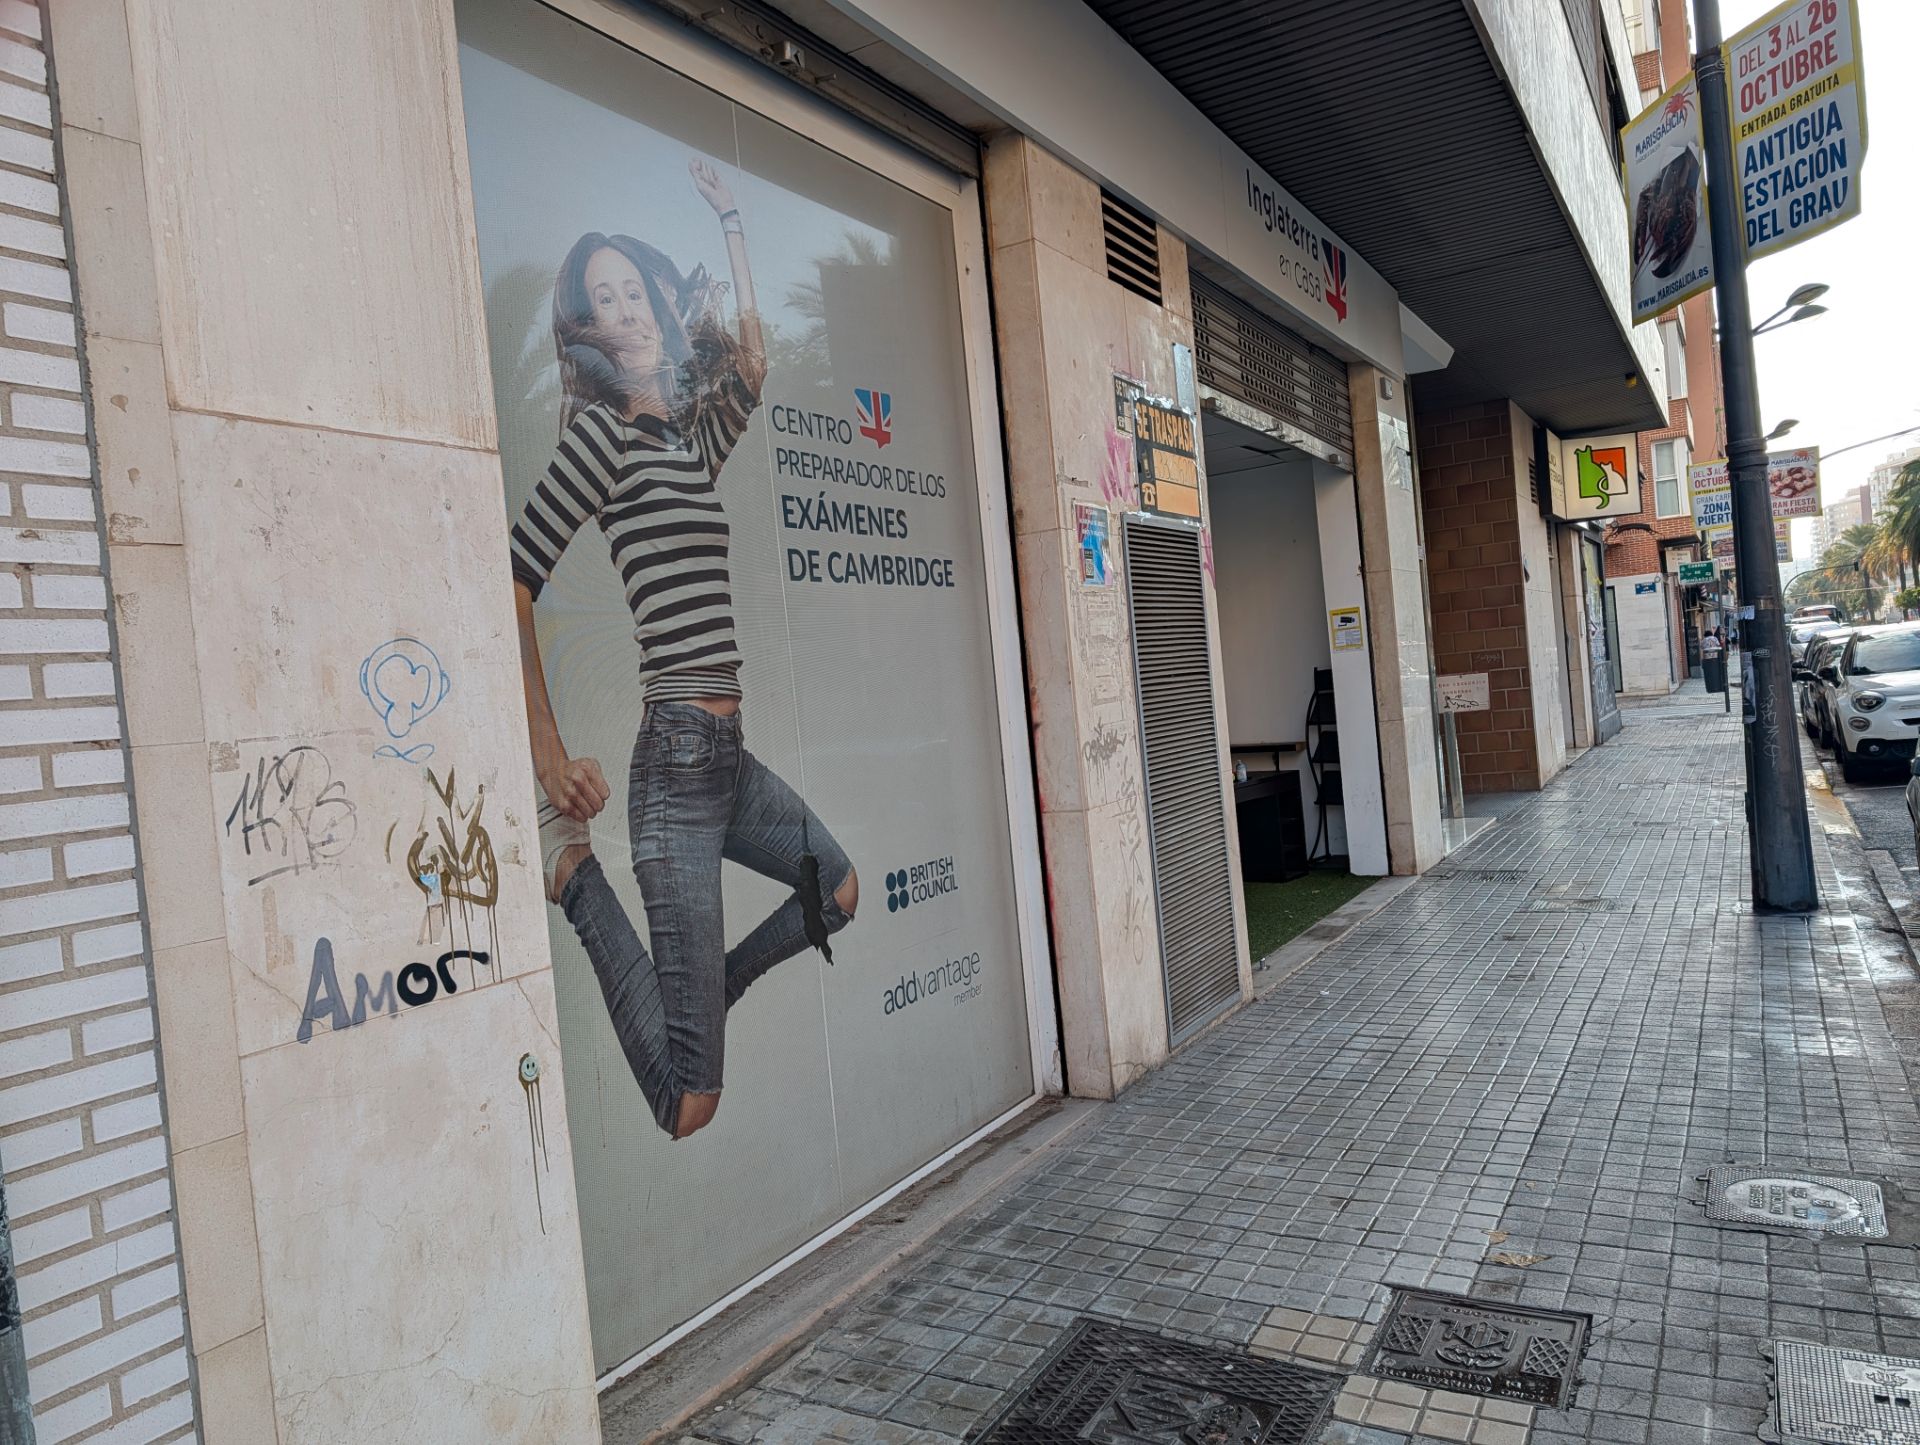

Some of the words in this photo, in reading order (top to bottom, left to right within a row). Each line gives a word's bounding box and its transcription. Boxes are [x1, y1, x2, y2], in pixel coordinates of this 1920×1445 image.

[1739, 45, 1765, 78] DEL
[1768, 25, 1782, 58] 3
[1786, 20, 1805, 50] AL
[1807, 0, 1837, 35] 26
[1740, 29, 1838, 113] OCTUBRE
[1741, 103, 1787, 138] ENTRADA
[1789, 73, 1840, 111] GRATUITA
[1635, 110, 1685, 158] MARISGALICIA
[1744, 101, 1843, 178] ANTIGUA
[1743, 138, 1847, 213] ESTACIÓN
[1246, 168, 1319, 261] Inglaterra
[1746, 208, 1784, 248] DEL
[1789, 176, 1848, 228] GRAU
[1279, 254, 1292, 281] en
[1295, 261, 1322, 302] casa
[771, 405, 852, 445] CENTRO
[1136, 402, 1149, 440] SE
[776, 447, 894, 491] PREPARADOR
[895, 468, 917, 495] DE
[918, 472, 946, 498] LOS
[1694, 475, 1730, 489] OCTUBR
[1706, 467, 1713, 476] 3
[1723, 465, 1729, 474] 2
[781, 491, 908, 539] EXÁMENES
[1696, 496, 1713, 505] GRAN
[1697, 512, 1732, 526] PUERT
[1703, 501, 1730, 515] ZONA
[1784, 506, 1817, 515] MARISCO
[1790, 498, 1816, 506] FIESTA
[787, 548, 823, 583] DE
[827, 551, 955, 588] CAMBRIDGE
[910, 856, 954, 885] BRITISH
[911, 875, 958, 904] COUNCIL
[883, 951, 981, 1016] addvantage
[953, 983, 983, 1007] member
